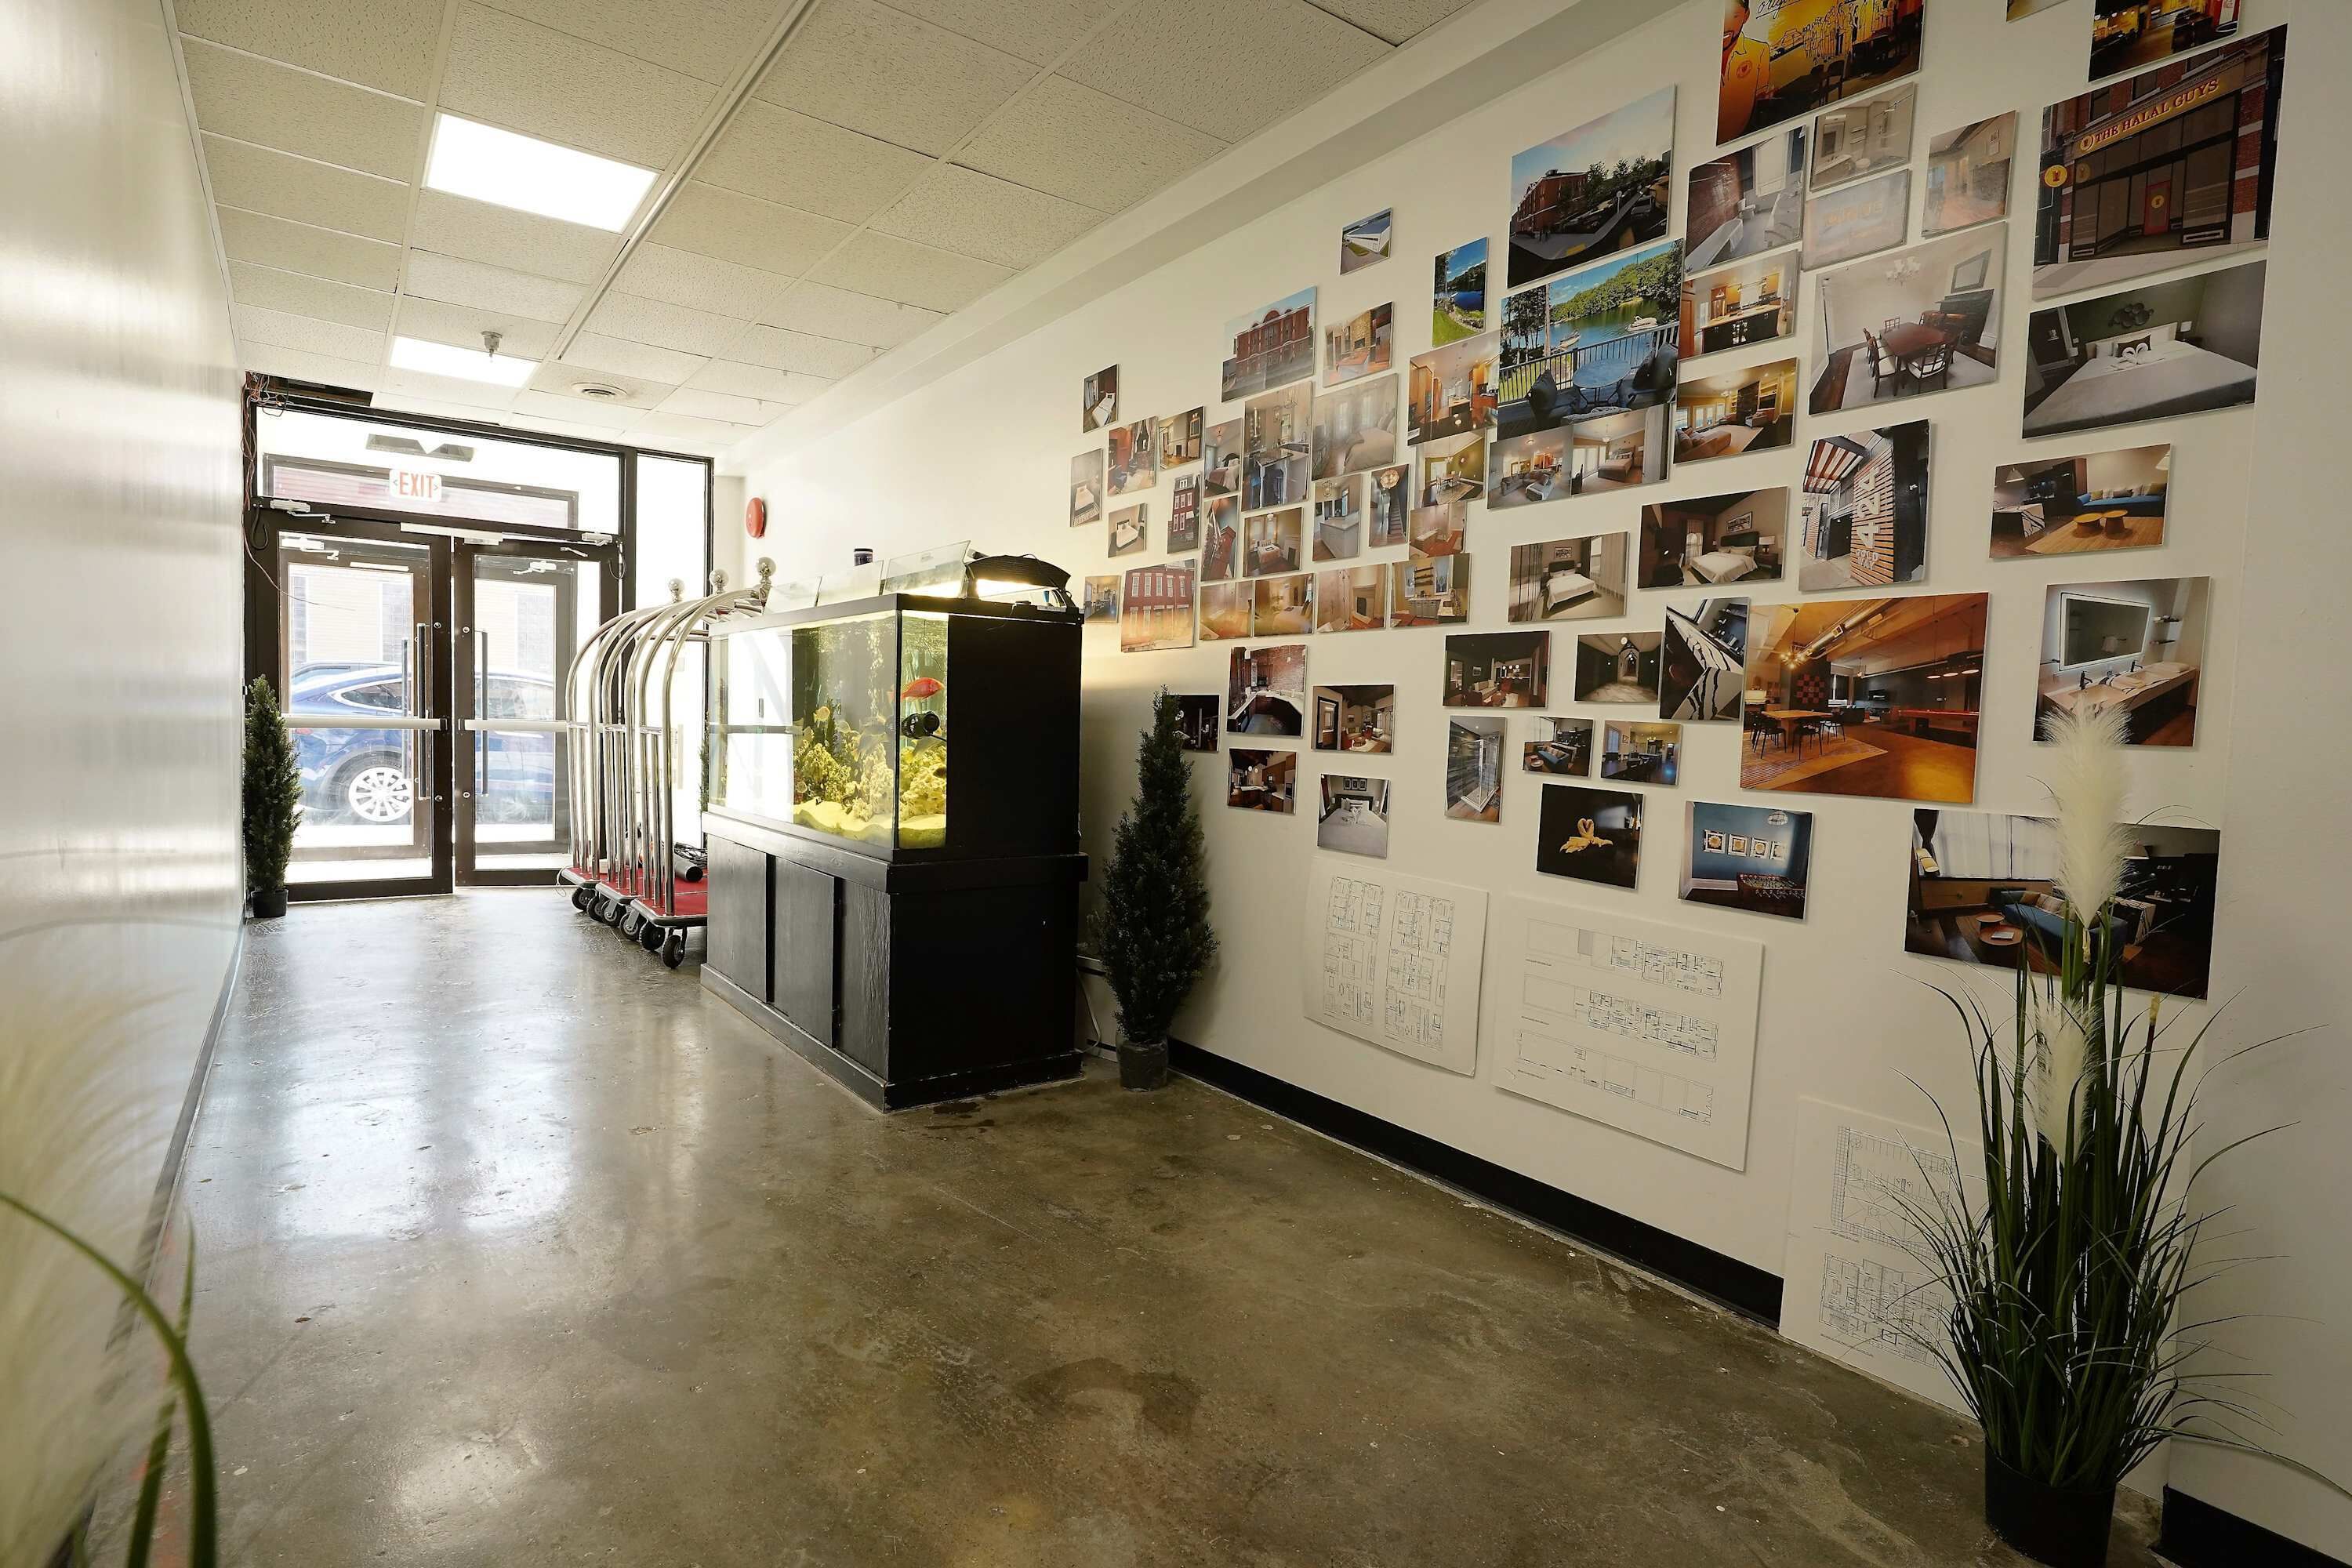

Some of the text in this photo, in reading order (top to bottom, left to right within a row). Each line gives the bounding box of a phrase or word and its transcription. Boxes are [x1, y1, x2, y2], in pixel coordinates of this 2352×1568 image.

[2096, 80, 2219, 143] THE HALAL GUYS
[399, 471, 435, 498] EXIT
